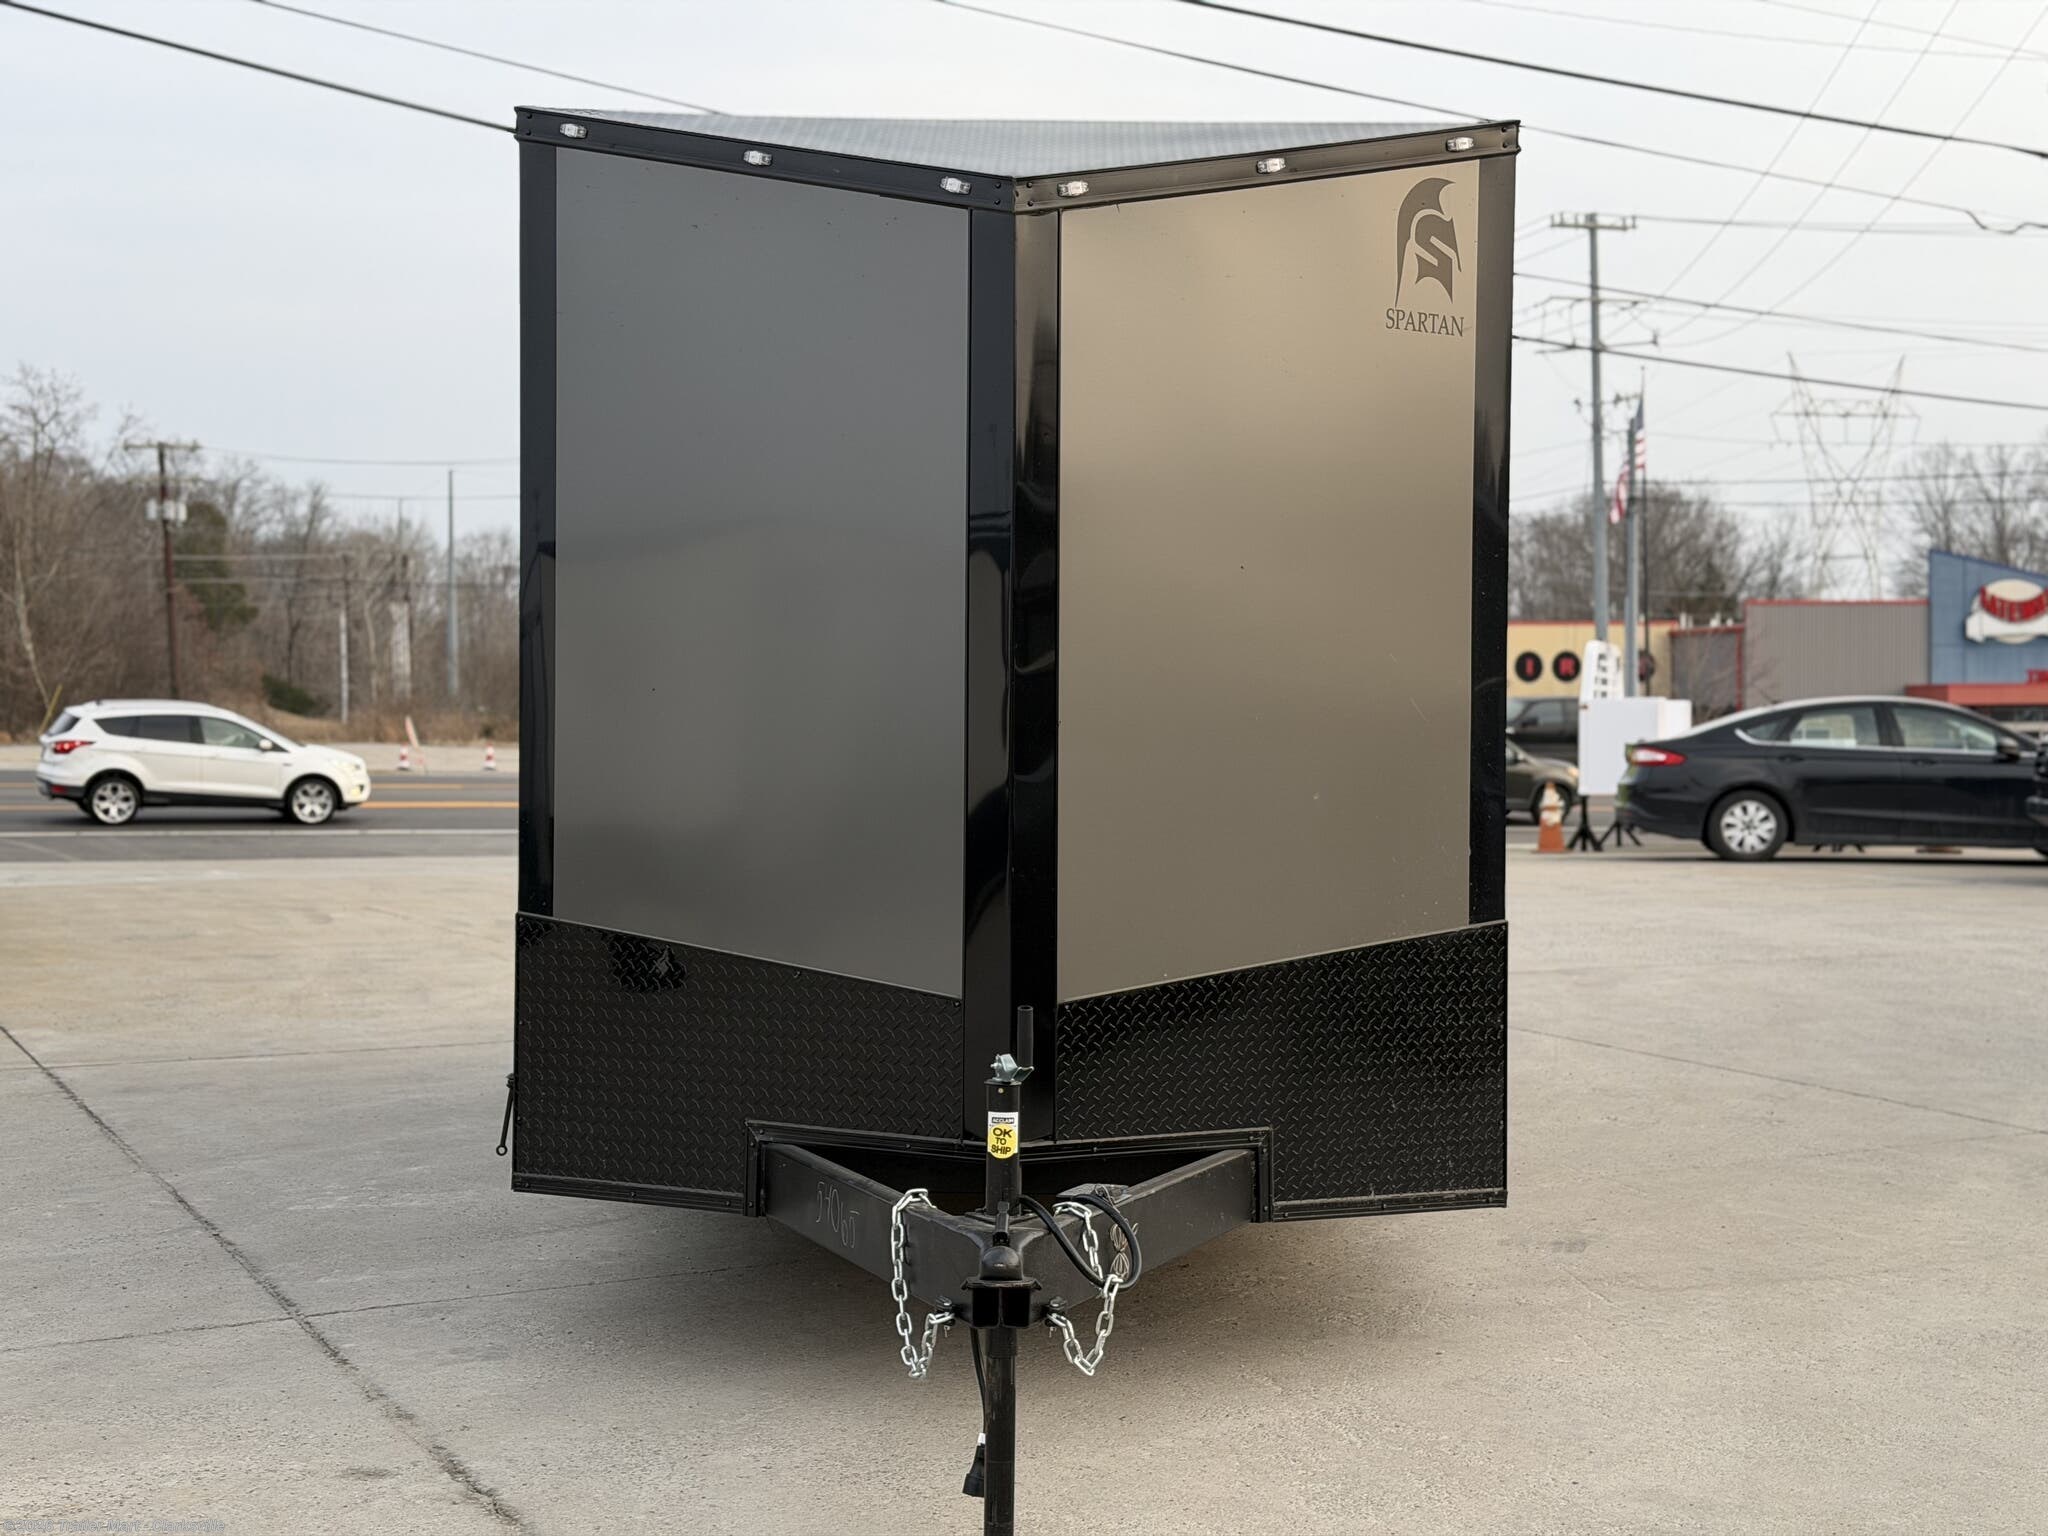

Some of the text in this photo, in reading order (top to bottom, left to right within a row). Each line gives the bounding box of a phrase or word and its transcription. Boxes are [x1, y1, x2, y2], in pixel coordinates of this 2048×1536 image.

[1386, 307, 1464, 337] SPARTAN
[992, 1127, 1013, 1138] OK
[995, 1137, 1007, 1145] TO
[991, 1144, 1012, 1155] SHIP
